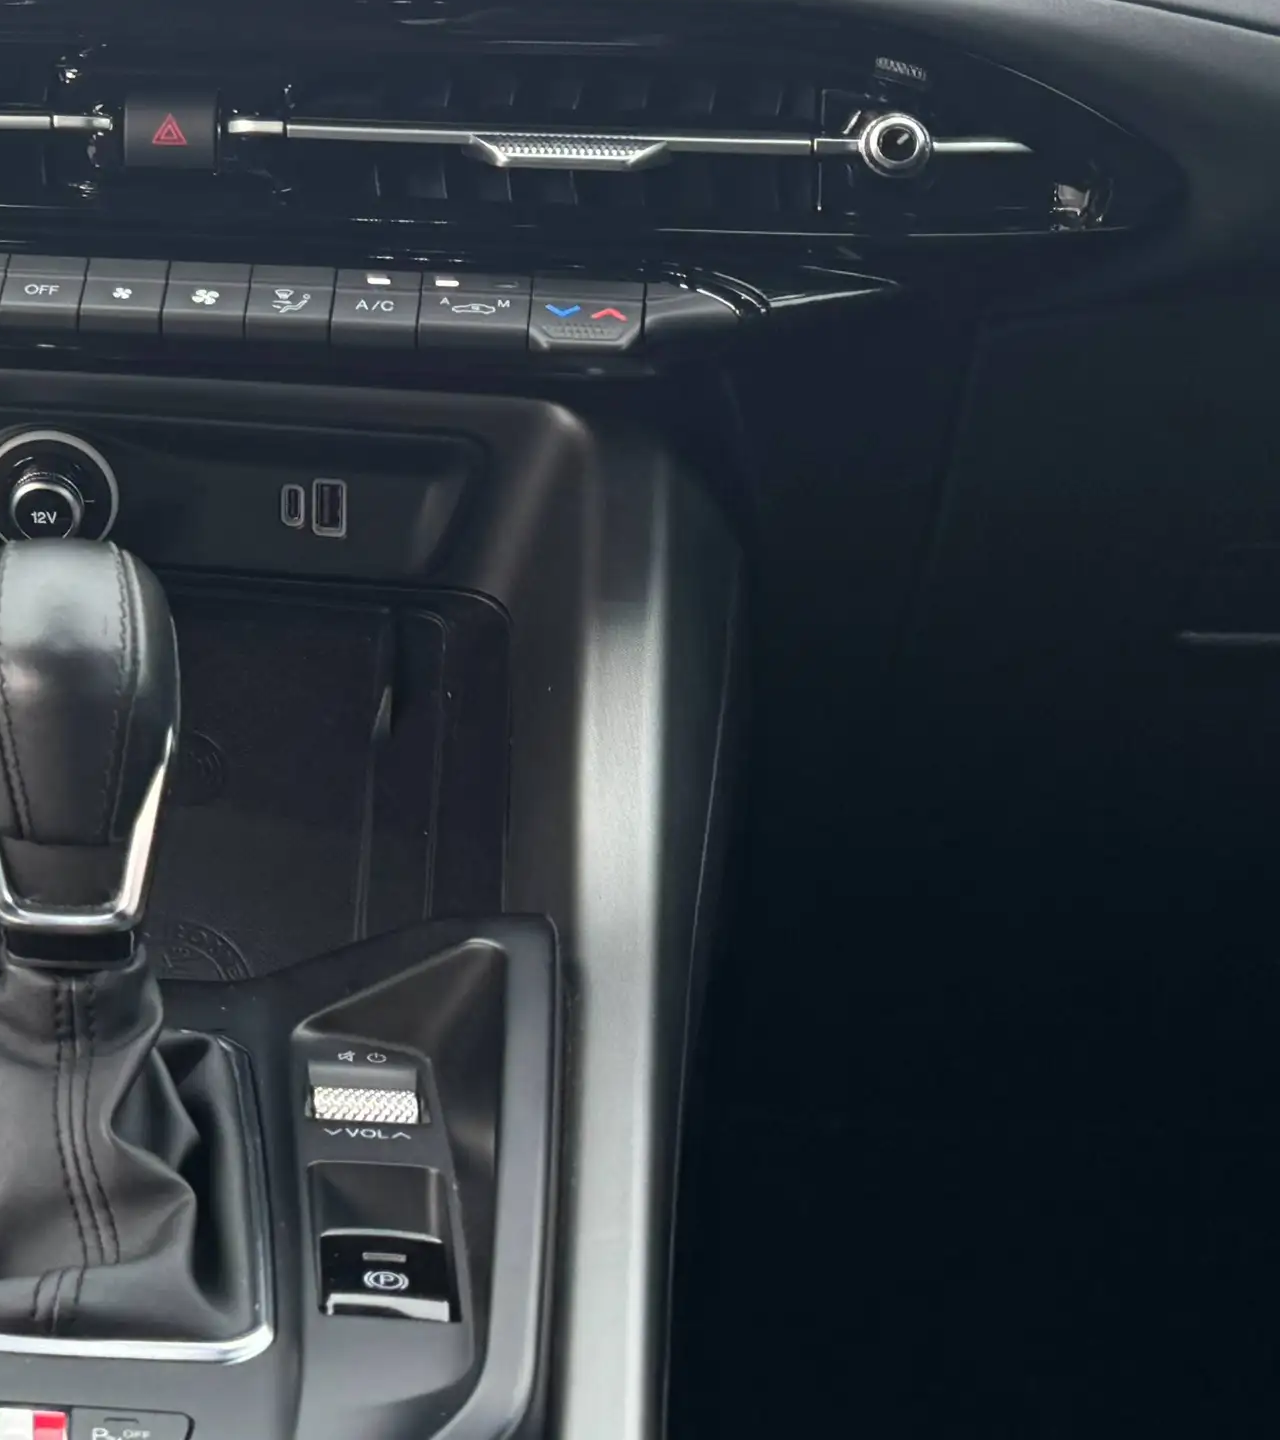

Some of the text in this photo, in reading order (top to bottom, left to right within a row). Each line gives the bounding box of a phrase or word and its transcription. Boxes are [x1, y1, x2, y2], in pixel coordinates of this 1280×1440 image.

[24, 283, 60, 297] OFF
[355, 299, 395, 314] A/C
[497, 299, 511, 309] M
[30, 511, 57, 524] 12V
[345, 1127, 389, 1139] VOL
[123, 1429, 151, 1439] OFF
